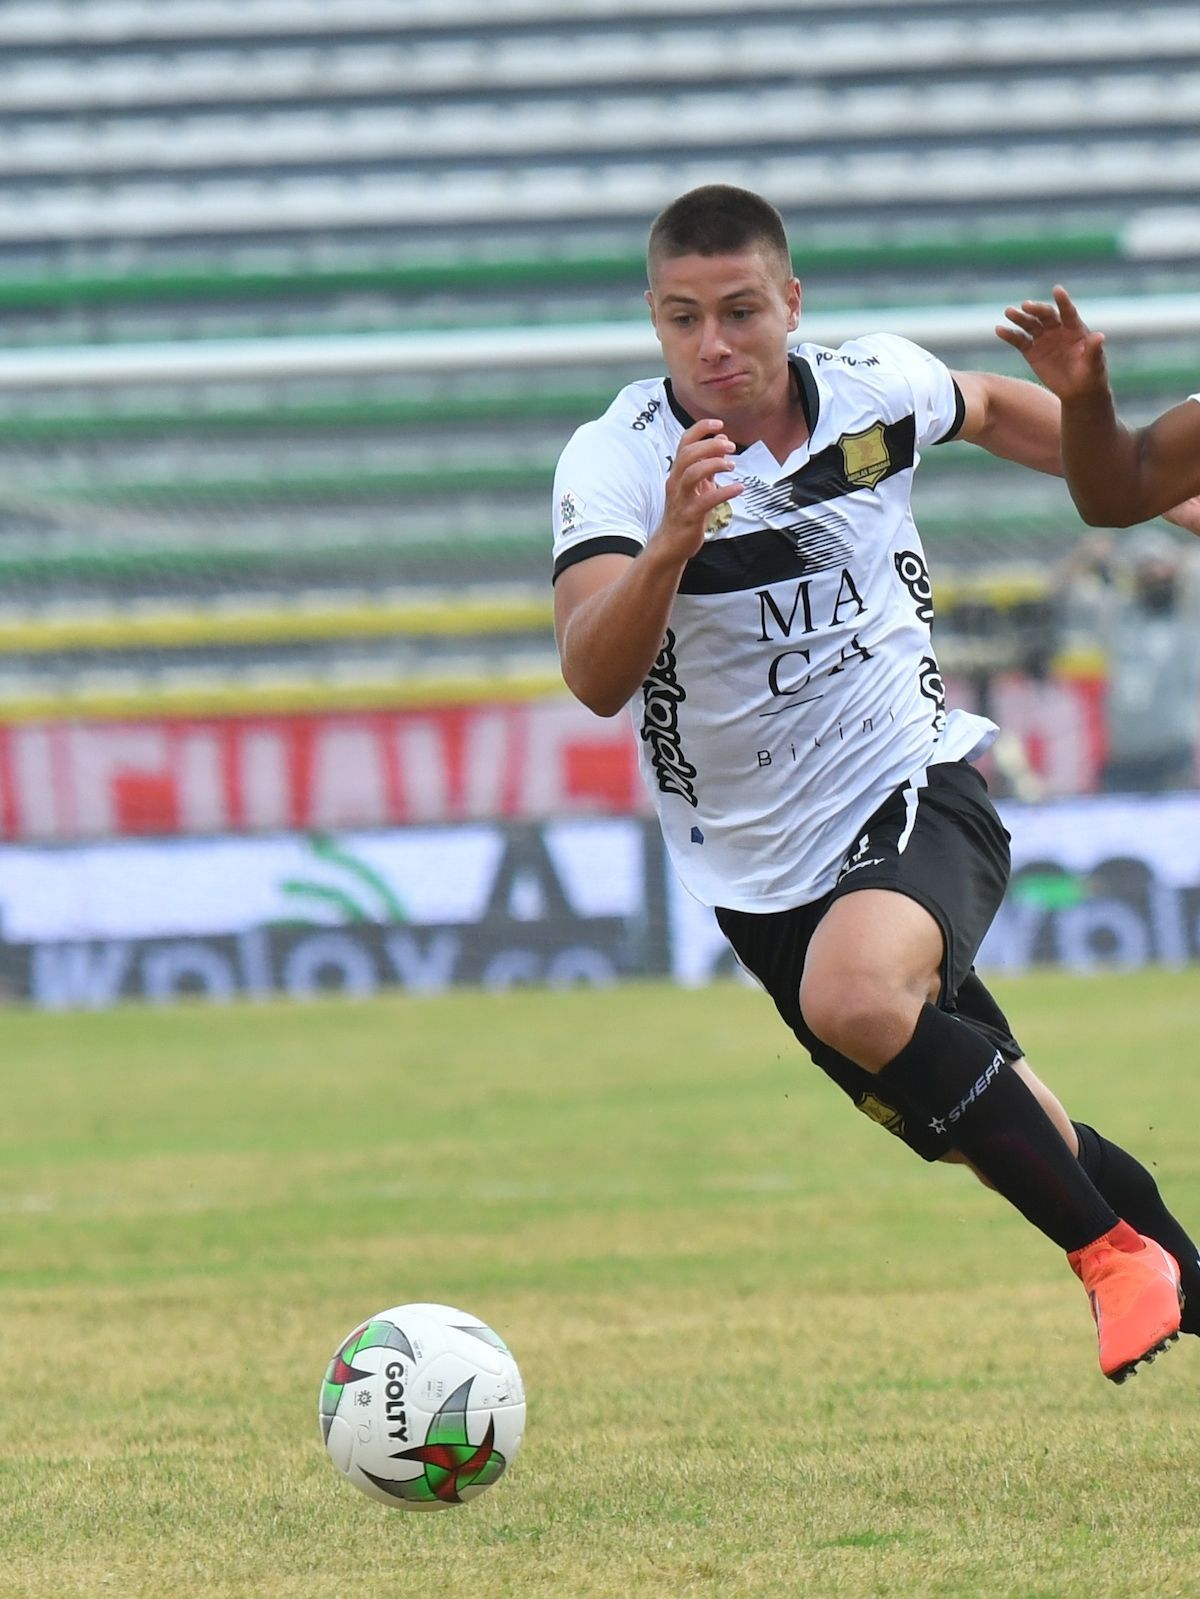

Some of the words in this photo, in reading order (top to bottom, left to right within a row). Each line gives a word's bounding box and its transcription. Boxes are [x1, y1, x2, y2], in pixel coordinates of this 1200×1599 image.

[754, 567, 869, 642] MA
[768, 633, 875, 697] CA
[385, 1361, 409, 1442] GOLTY
